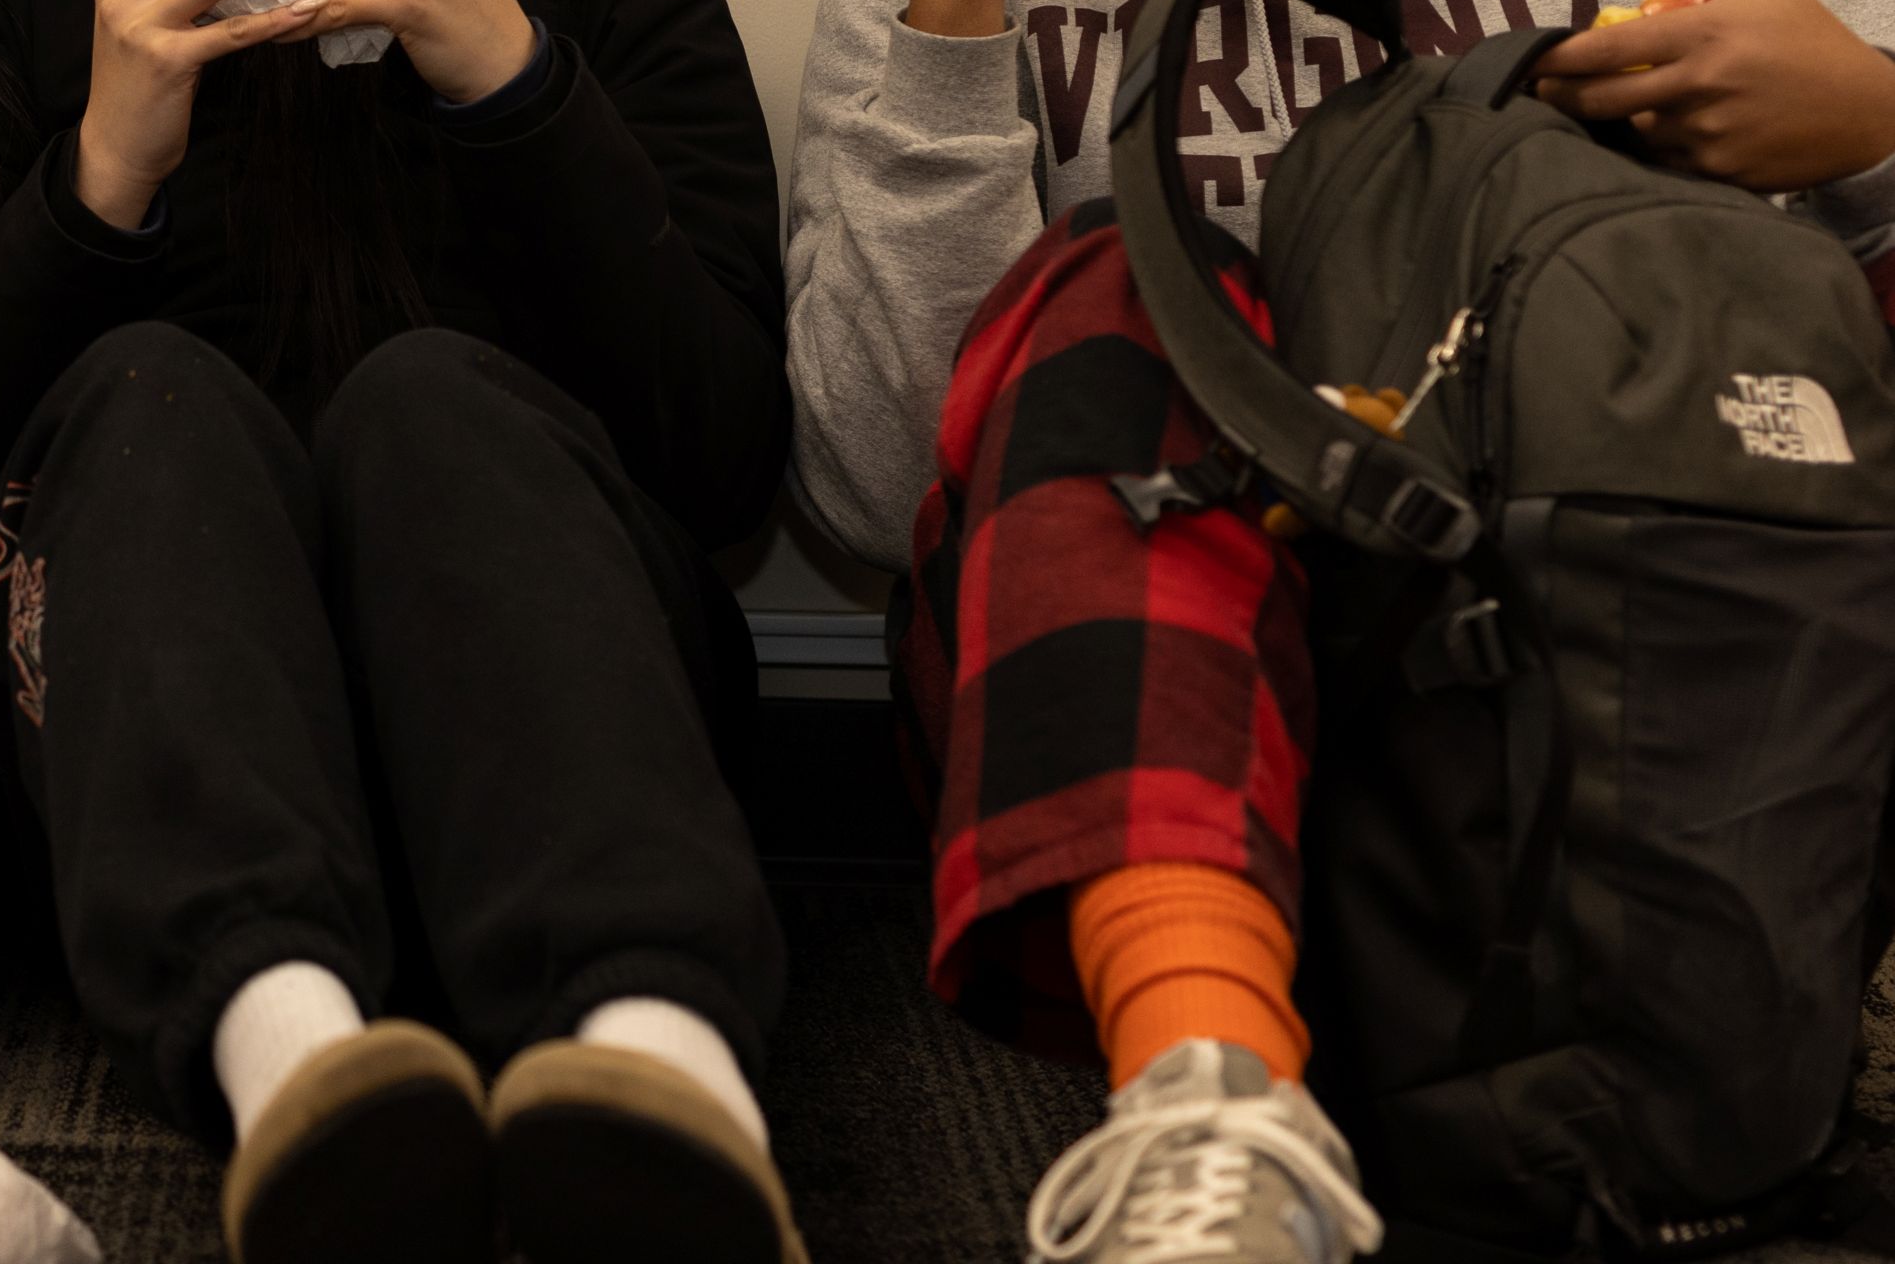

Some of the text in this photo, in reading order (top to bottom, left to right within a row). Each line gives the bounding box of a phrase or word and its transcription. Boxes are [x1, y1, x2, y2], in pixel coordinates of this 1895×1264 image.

[1731, 374, 1794, 405] THE
[1715, 394, 1800, 433] NORTH
[1740, 428, 1806, 463] FACE
